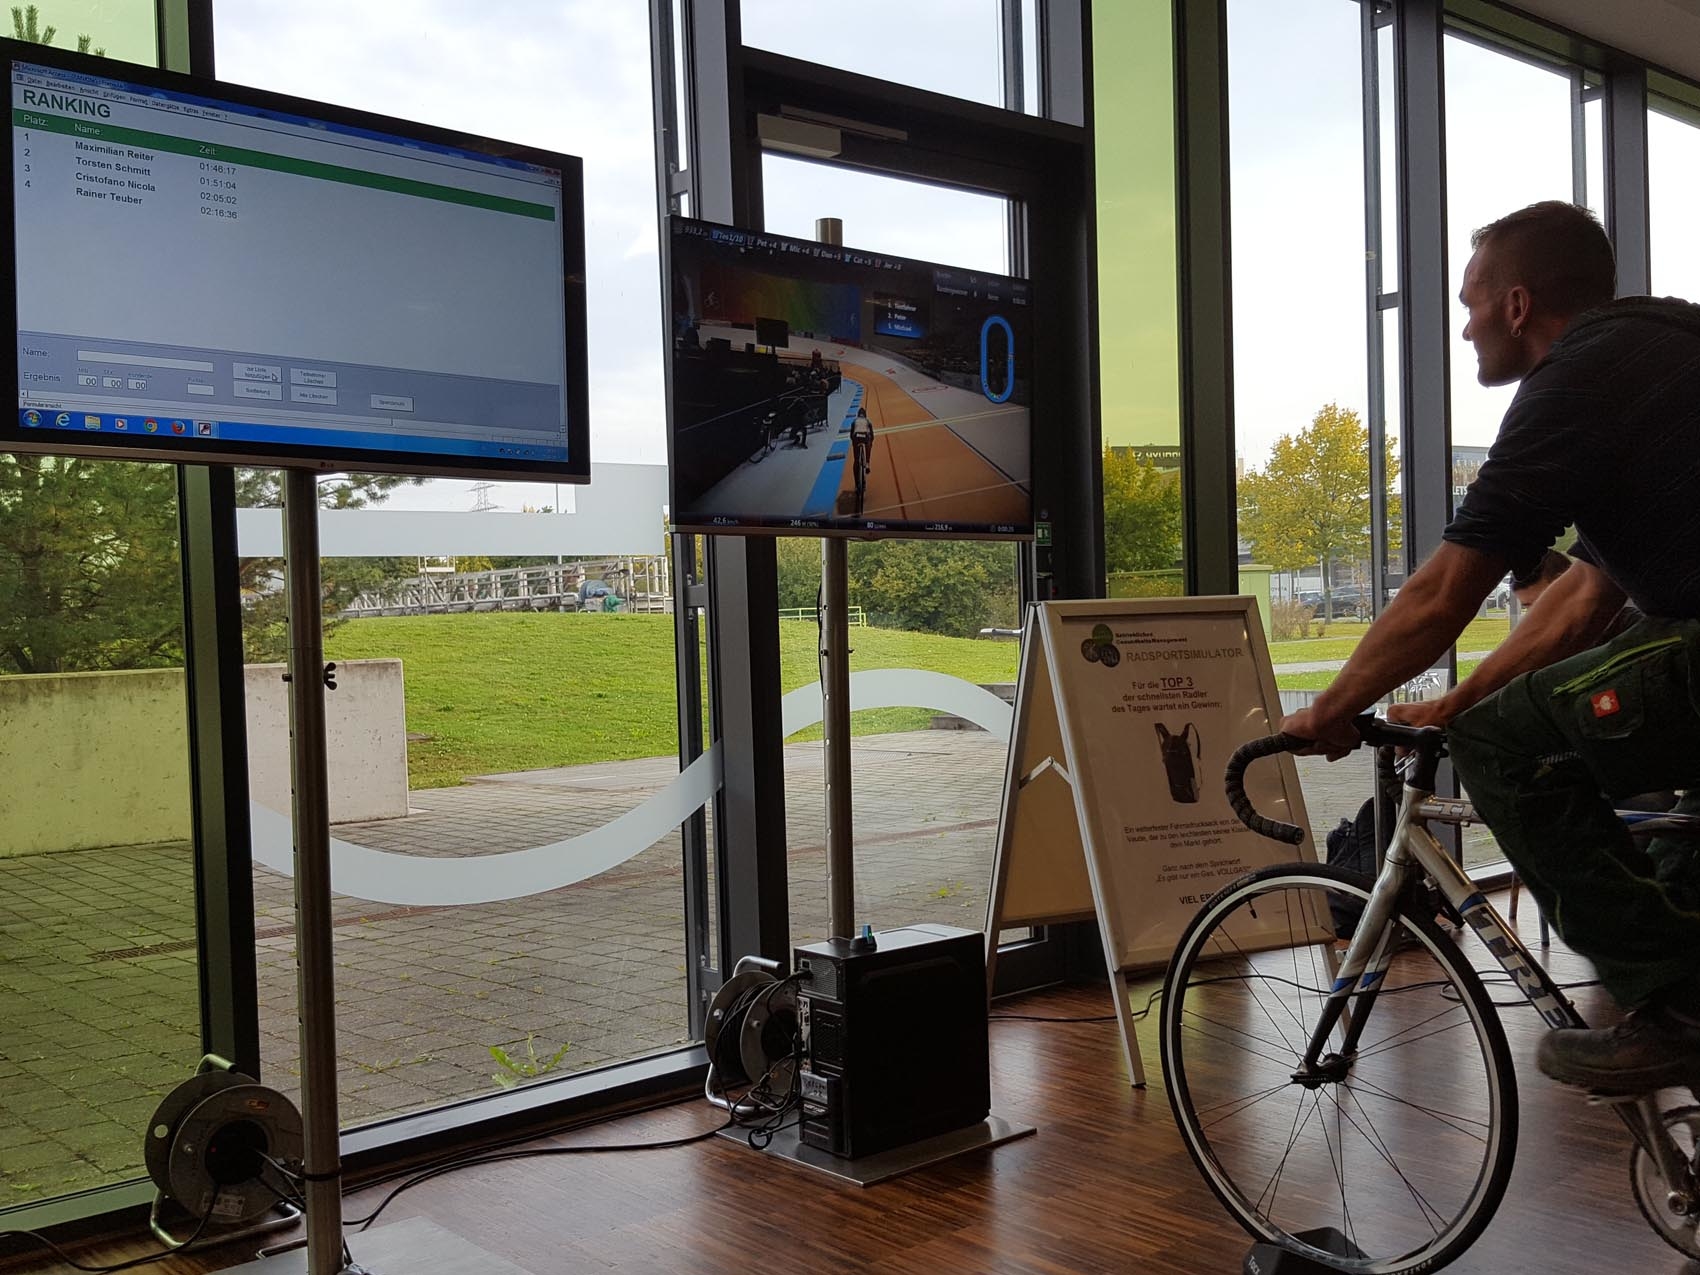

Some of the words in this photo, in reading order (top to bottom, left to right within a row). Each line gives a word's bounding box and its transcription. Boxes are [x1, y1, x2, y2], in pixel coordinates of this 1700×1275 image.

[23, 89, 111, 118] RANKING
[75, 141, 125, 157] Maximilian
[127, 150, 154, 162] Reiter
[24, 148, 30, 157] 2
[76, 156, 112, 170] Torsten
[114, 163, 151, 177] Schmitt
[200, 177, 237, 190] 01:51:04
[24, 163, 31, 173] 3
[75, 172, 126, 188] Cristofano
[127, 180, 156, 192] Nicola
[200, 191, 237, 205] 02:05:02
[24, 179, 31, 189] 4
[76, 187, 106, 200] Rainer
[110, 192, 143, 205] Teuber
[713, 516, 726, 526] 42,6
[790, 519, 801, 527] 246
[1126, 647, 1243, 663] RADSPORTSIMULATOR
[1132, 681, 1146, 690] Für
[1147, 681, 1160, 690] die
[1160, 677, 1184, 688] TOP
[1186, 676, 1194, 687] 3
[1122, 693, 1136, 702] der
[1137, 691, 1182, 700] schnellsten
[1182, 690, 1208, 699] Radler
[1111, 704, 1126, 713] des
[1127, 703, 1151, 714] Tages
[1152, 703, 1177, 711] wartet
[1177, 702, 1190, 710] ein
[1179, 894, 1200, 905] VIEL
[1475, 912, 1575, 1030] TRE
